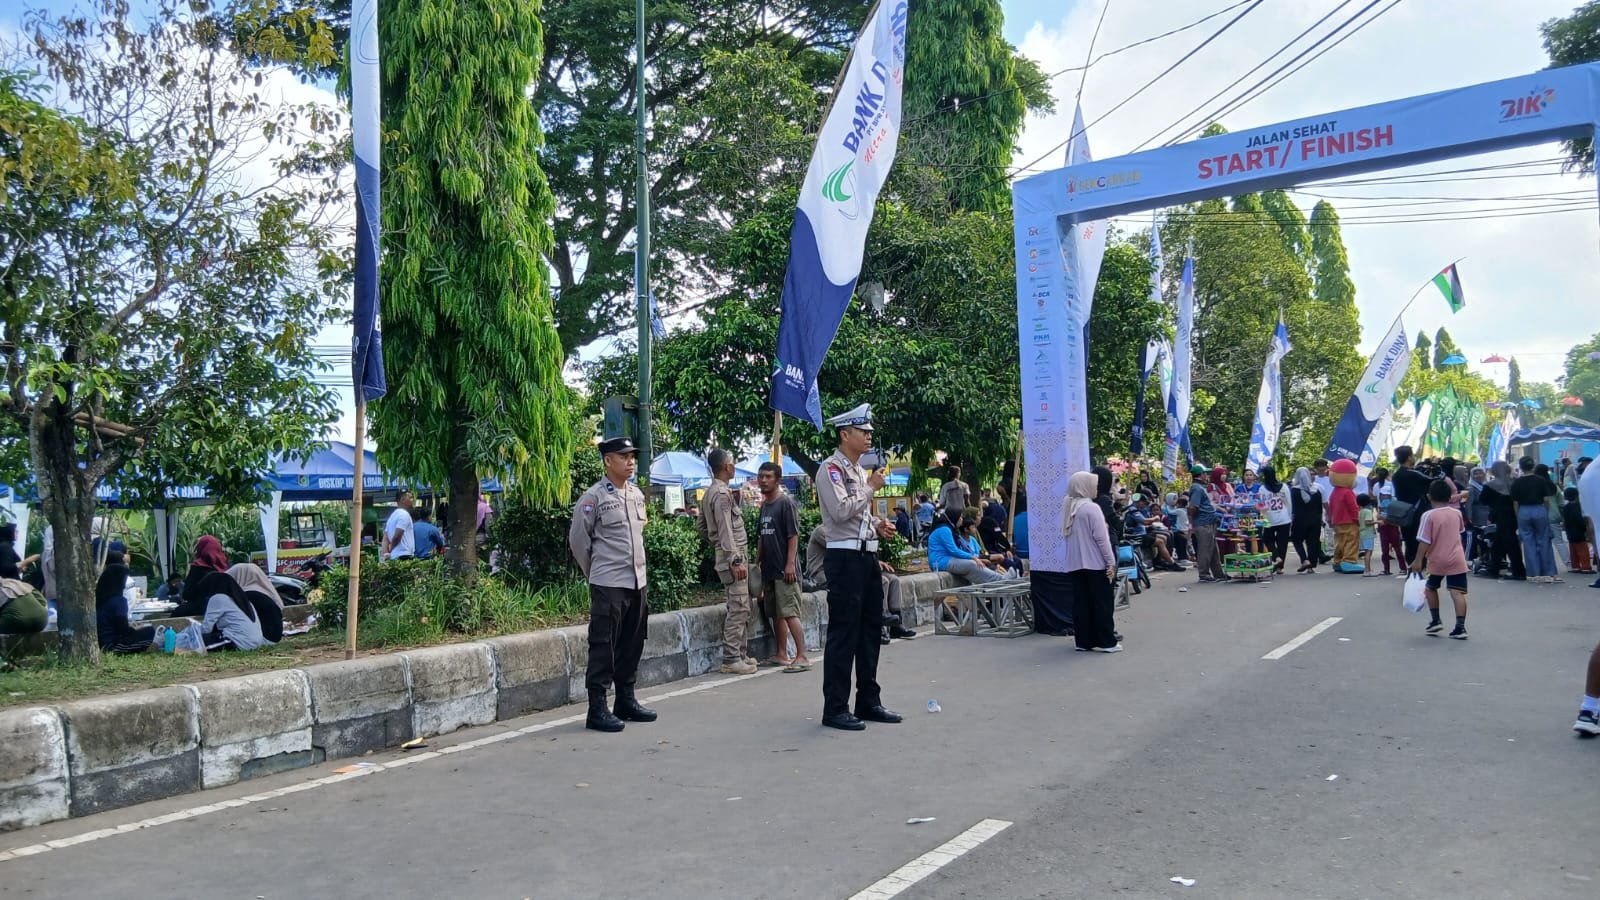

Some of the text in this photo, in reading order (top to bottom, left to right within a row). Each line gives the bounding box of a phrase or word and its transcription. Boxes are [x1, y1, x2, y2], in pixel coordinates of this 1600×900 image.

[842, 81, 883, 154] BANK
[1246, 120, 1338, 148] JALAN SEHAT
[1301, 124, 1394, 161] FINISH
[1375, 354, 1395, 379] BANK
